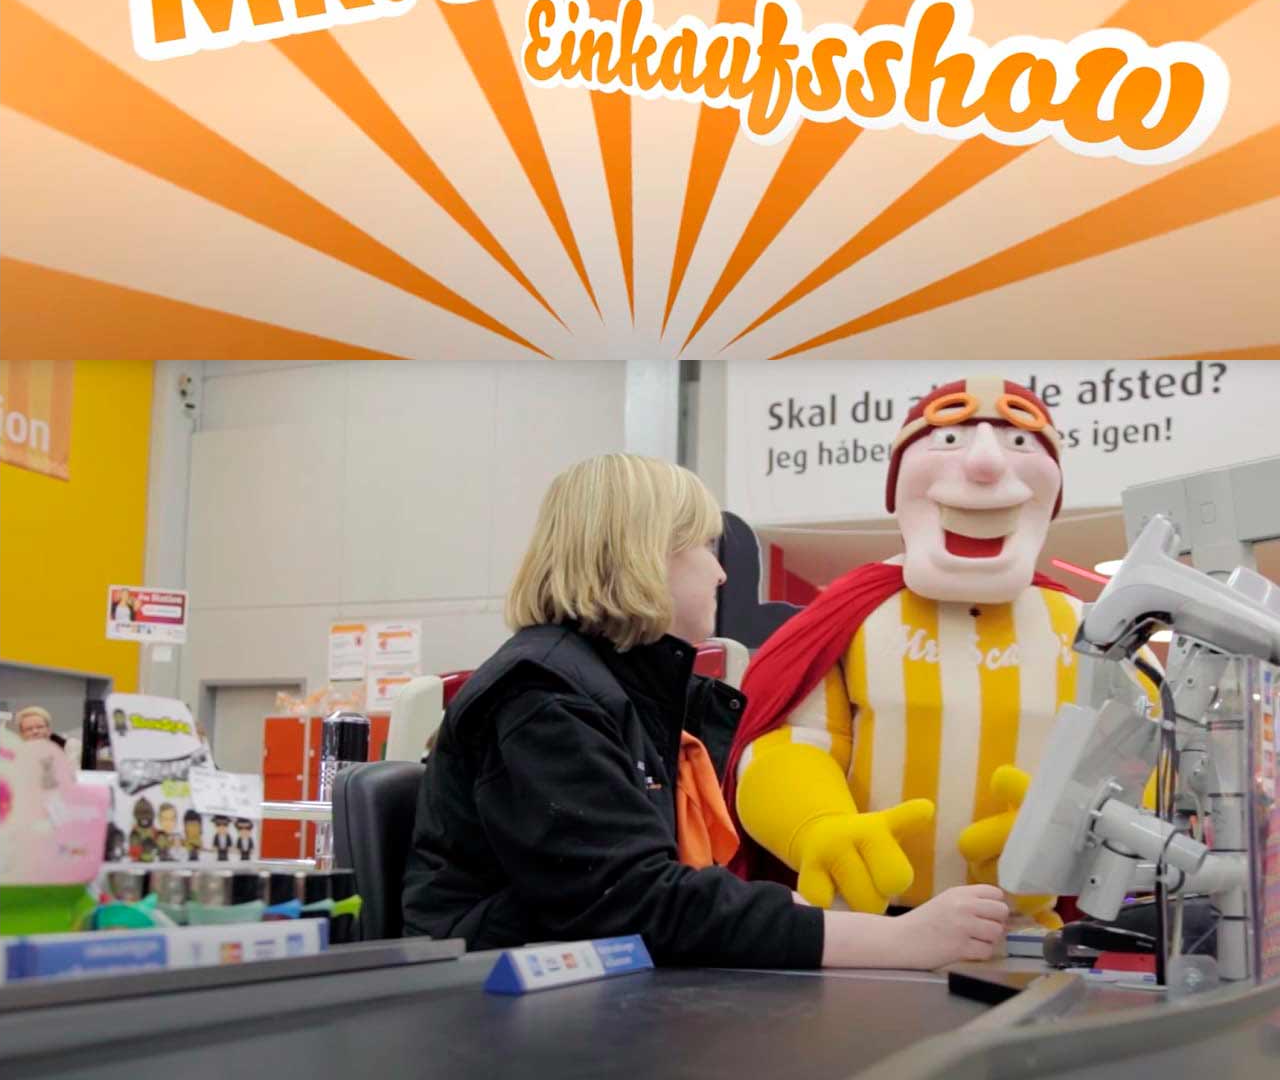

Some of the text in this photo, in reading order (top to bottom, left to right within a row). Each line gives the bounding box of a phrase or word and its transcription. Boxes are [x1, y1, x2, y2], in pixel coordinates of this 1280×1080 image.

[768, 398, 837, 432] Skal
[851, 391, 894, 425] du
[1076, 360, 1228, 407] afsted?
[766, 447, 809, 476] Jeg
[1093, 417, 1174, 453] igen!
